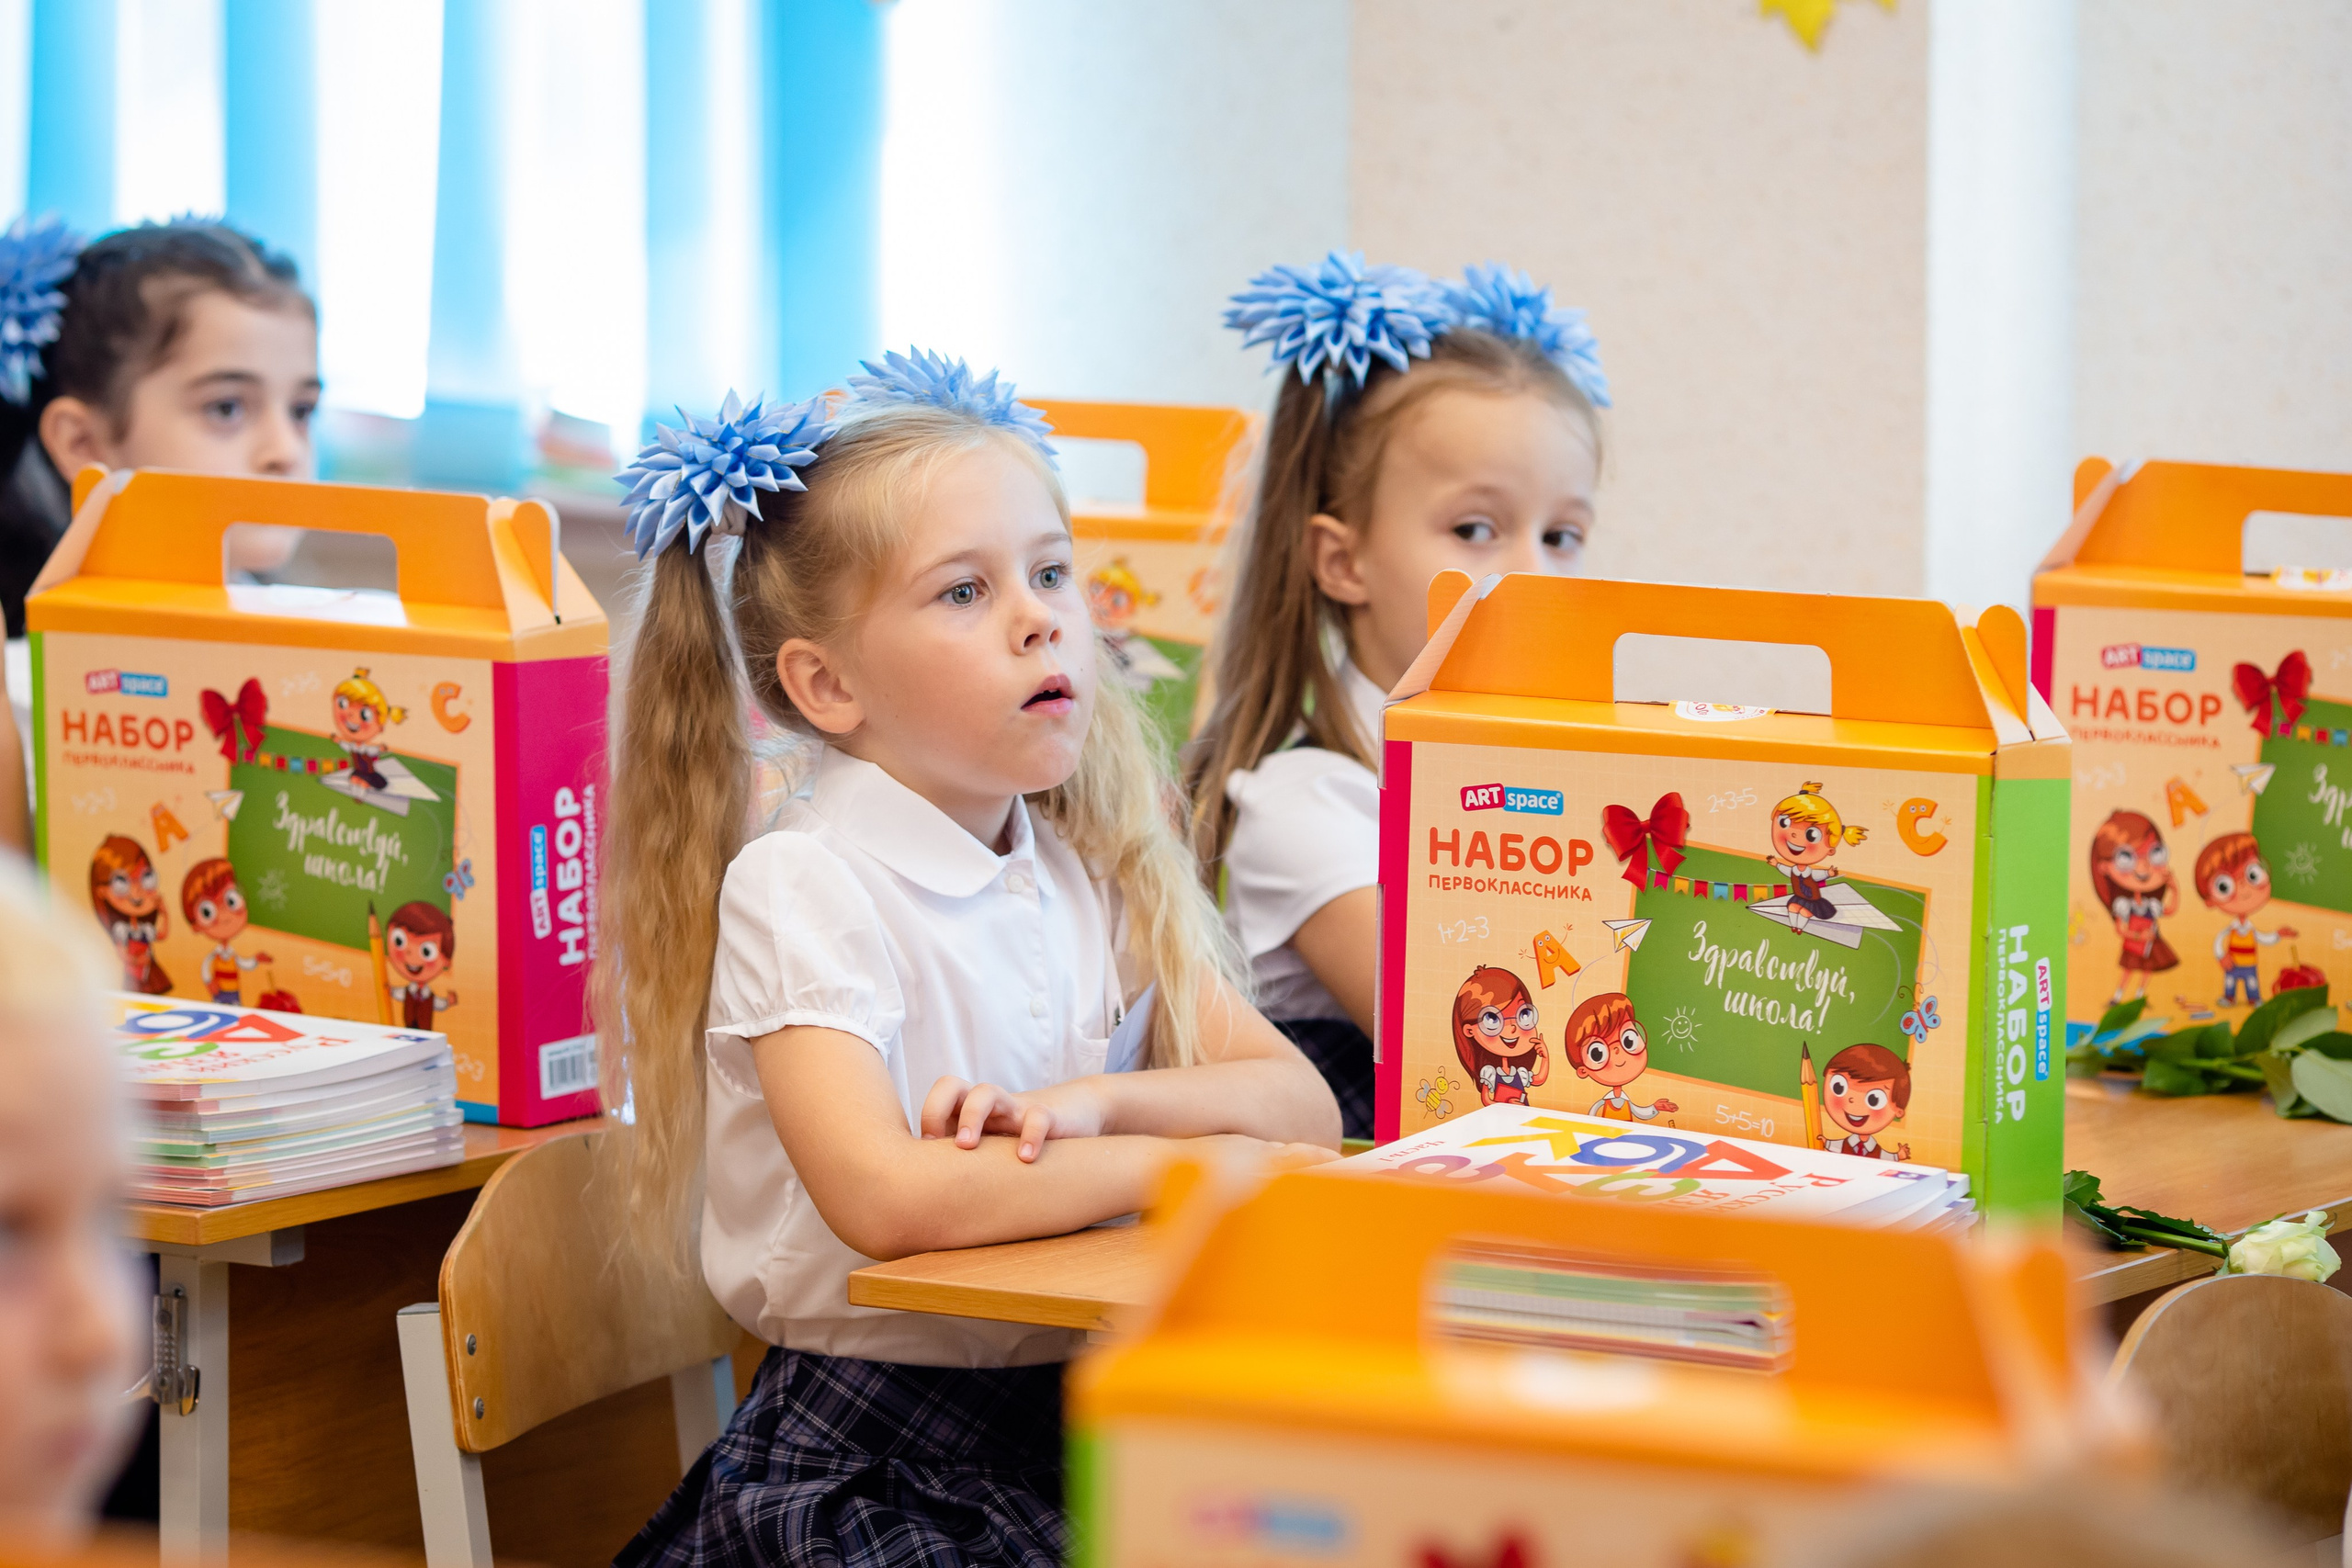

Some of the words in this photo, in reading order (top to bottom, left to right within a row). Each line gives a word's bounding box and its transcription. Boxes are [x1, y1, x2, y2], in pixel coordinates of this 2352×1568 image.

[2071, 684, 2222, 726] НАБОР
[62, 709, 195, 752] НАБОР
[1464, 786, 1501, 807] ART
[1707, 788, 1758, 813] 2+3=5
[1429, 827, 1594, 877] НАБОР
[554, 786, 586, 966] НАБОР
[1429, 874, 1592, 901] ПЕРВОКЛАССНИКА
[1438, 916, 1490, 943] 1+2=3
[1689, 920, 1855, 1007] Здравствуй,
[2038, 965, 2050, 1004] ART
[1724, 990, 1831, 1034] школа!
[1995, 929, 2007, 1123] ПЕРВОКЛАССНИКА
[2007, 924, 2029, 1121] НАБОР
[1715, 1104, 1774, 1137] 5+5=10
[1706, 1172, 1853, 1213] Русски
